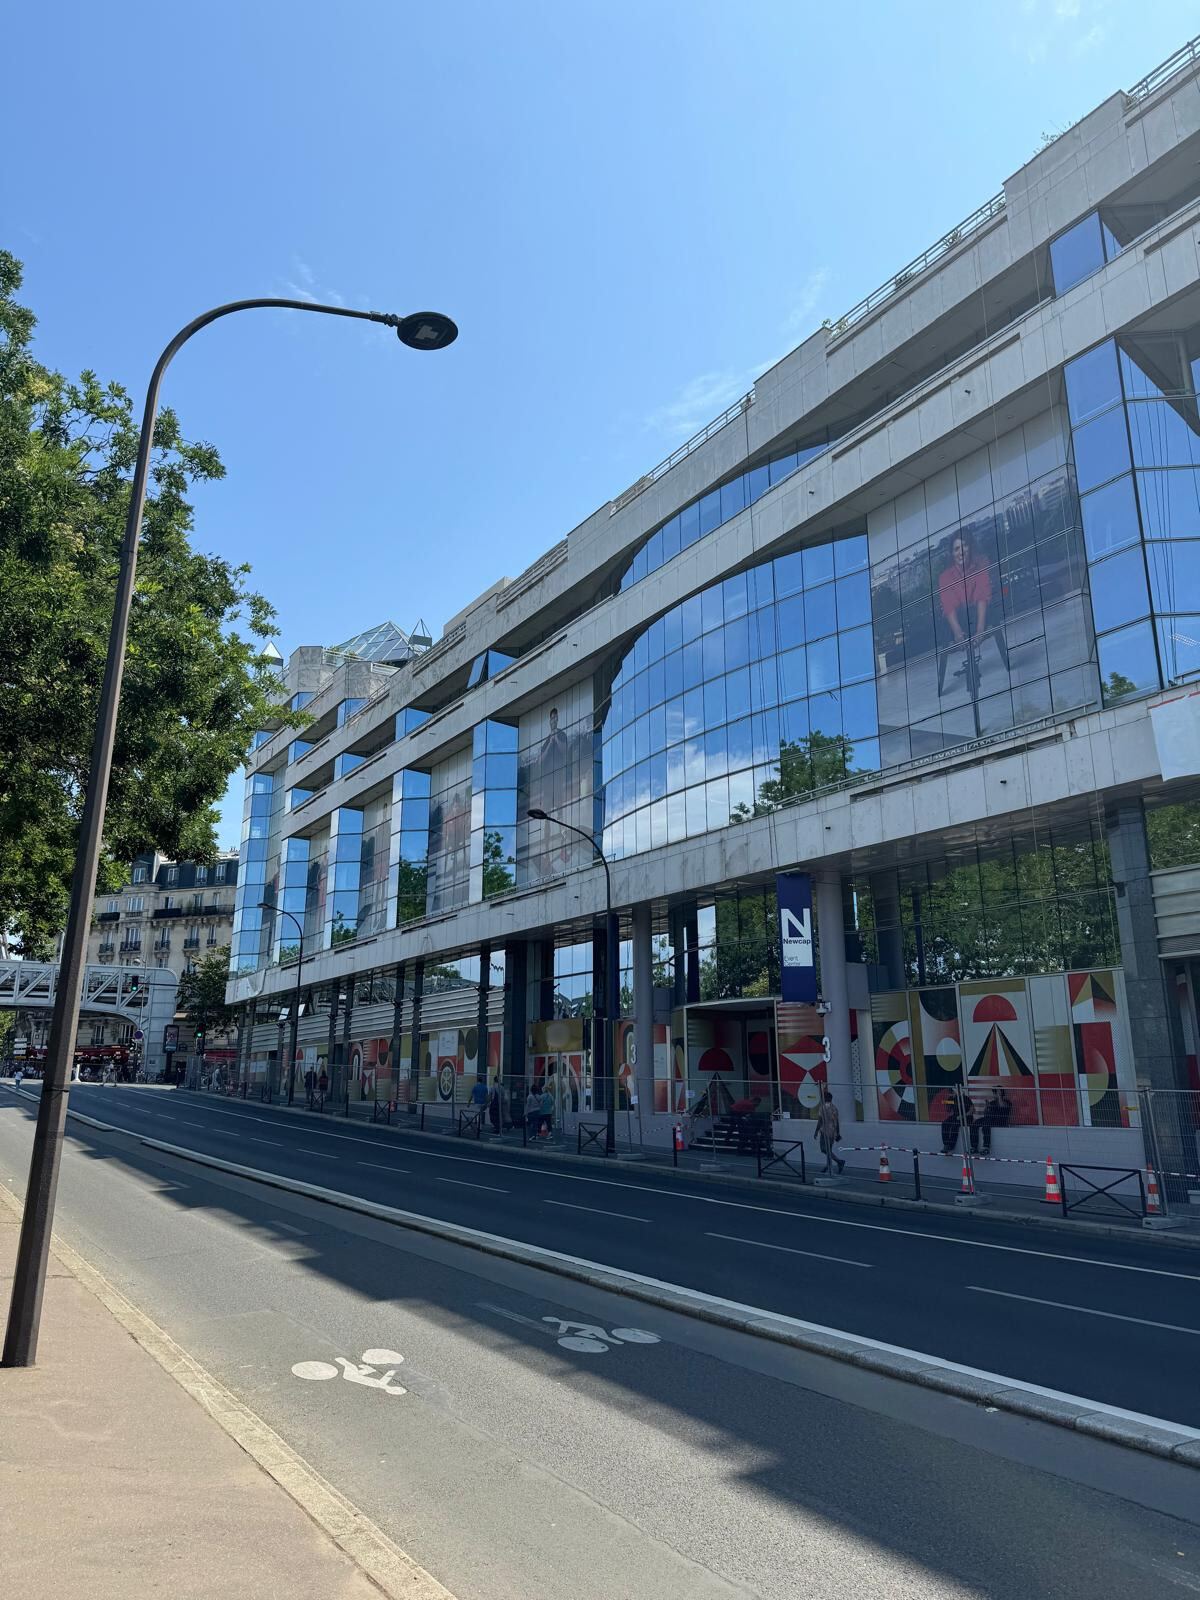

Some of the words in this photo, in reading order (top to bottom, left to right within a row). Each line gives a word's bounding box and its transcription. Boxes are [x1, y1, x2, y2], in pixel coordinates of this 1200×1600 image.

[781, 908, 811, 938] N
[630, 1044, 636, 1064] 3
[822, 1036, 831, 1063] 3
